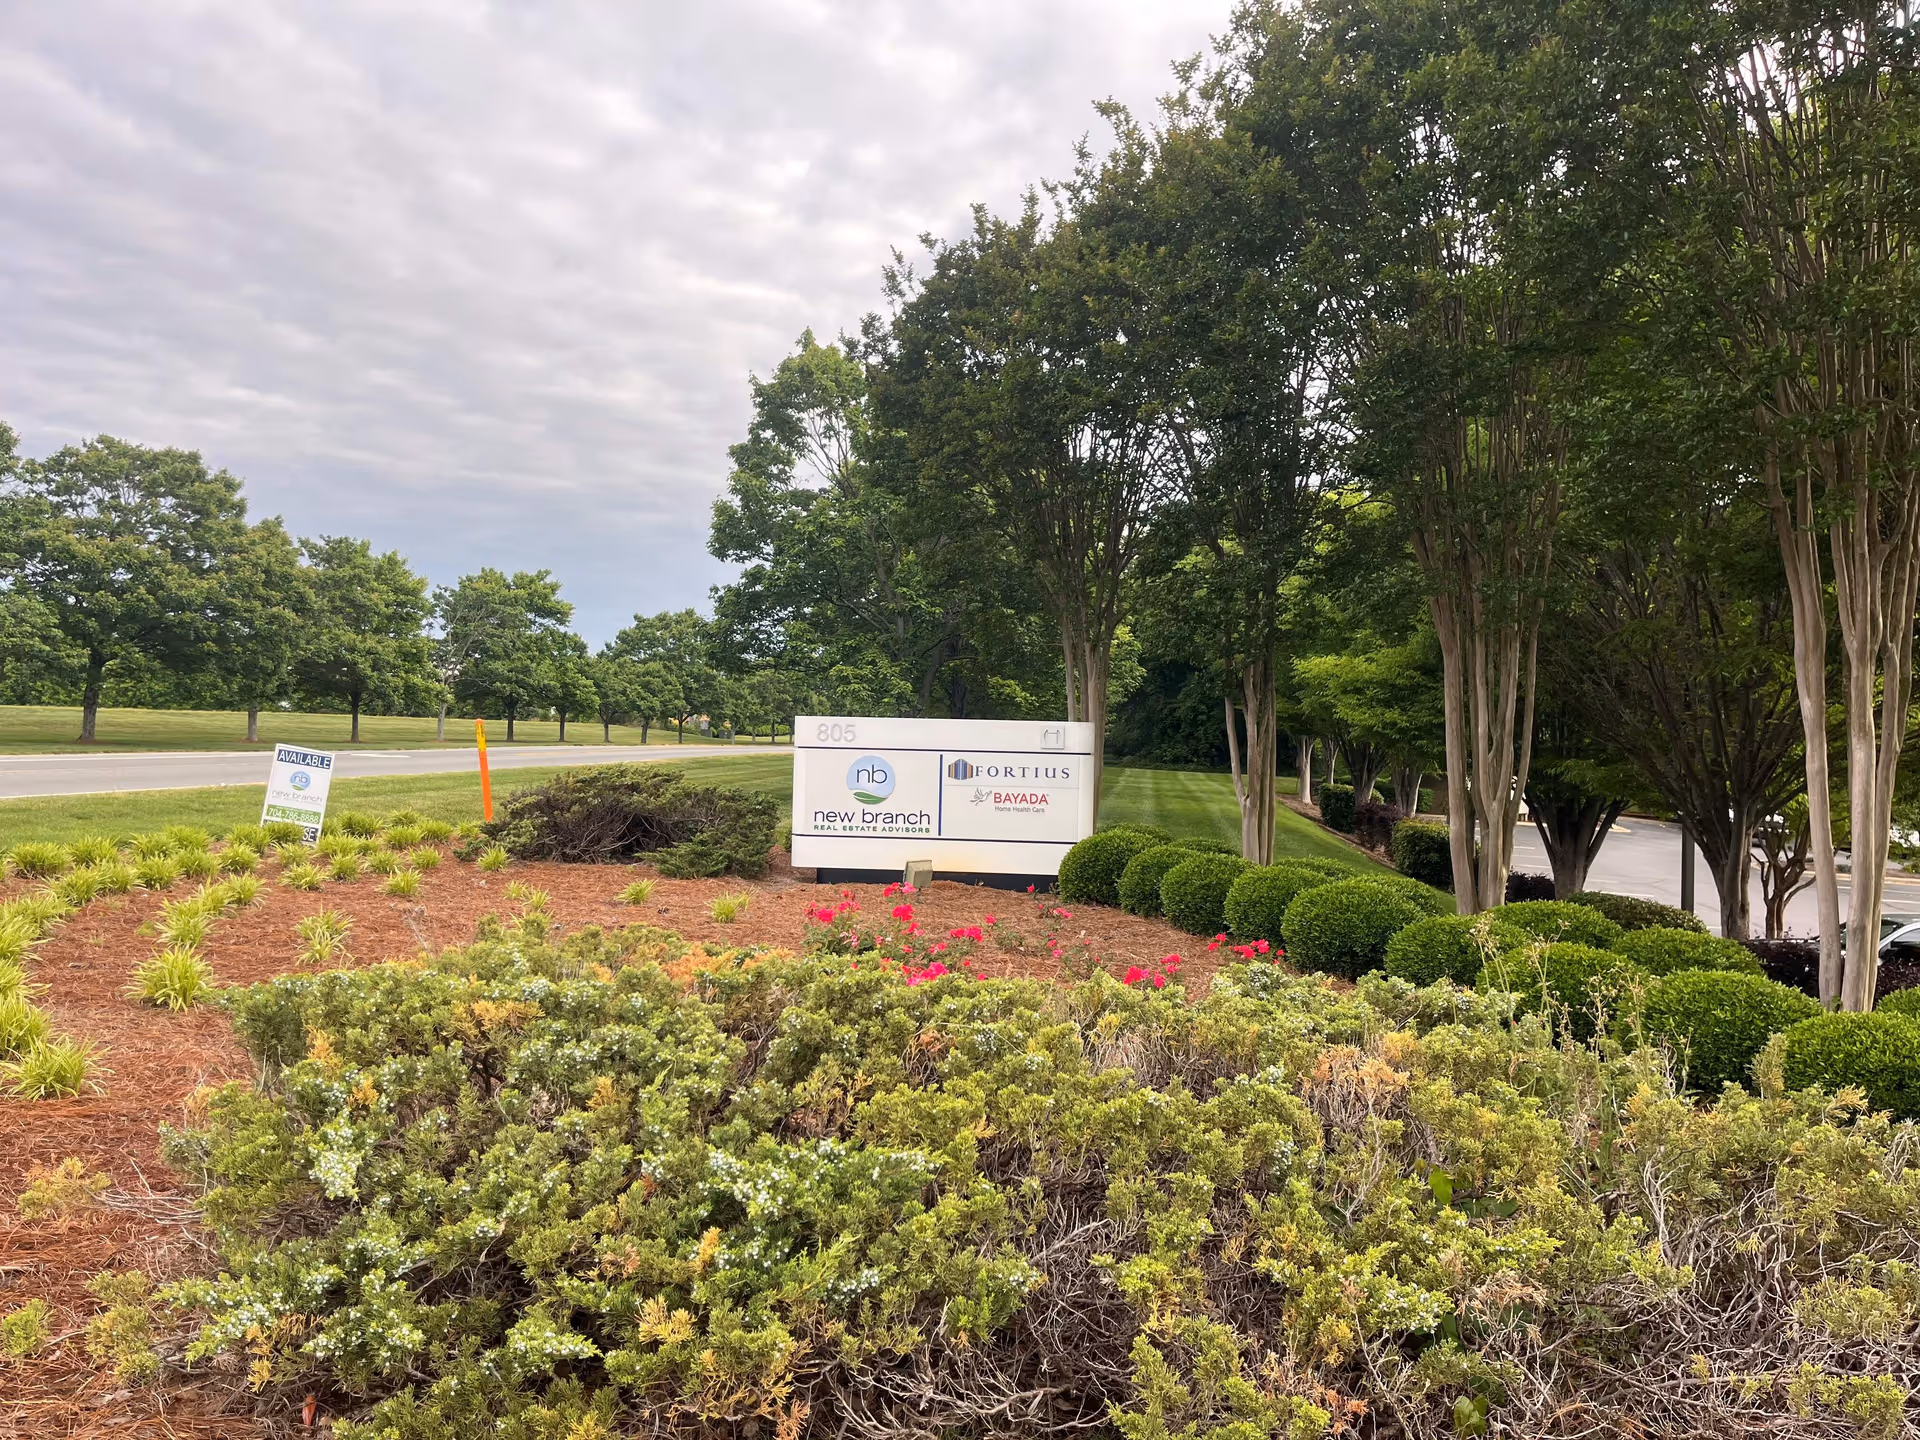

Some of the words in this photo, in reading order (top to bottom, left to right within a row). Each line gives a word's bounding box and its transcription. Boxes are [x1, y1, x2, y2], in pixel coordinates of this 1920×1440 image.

[816, 723, 856, 743] 805
[278, 750, 330, 768] AVAILABLE
[856, 765, 888, 785] nb
[975, 765, 1070, 779] FORTIUS
[271, 789, 291, 798] new
[292, 791, 322, 802] branch
[993, 792, 1049, 805] BAYADA
[813, 810, 855, 823] new
[861, 808, 931, 825] branch
